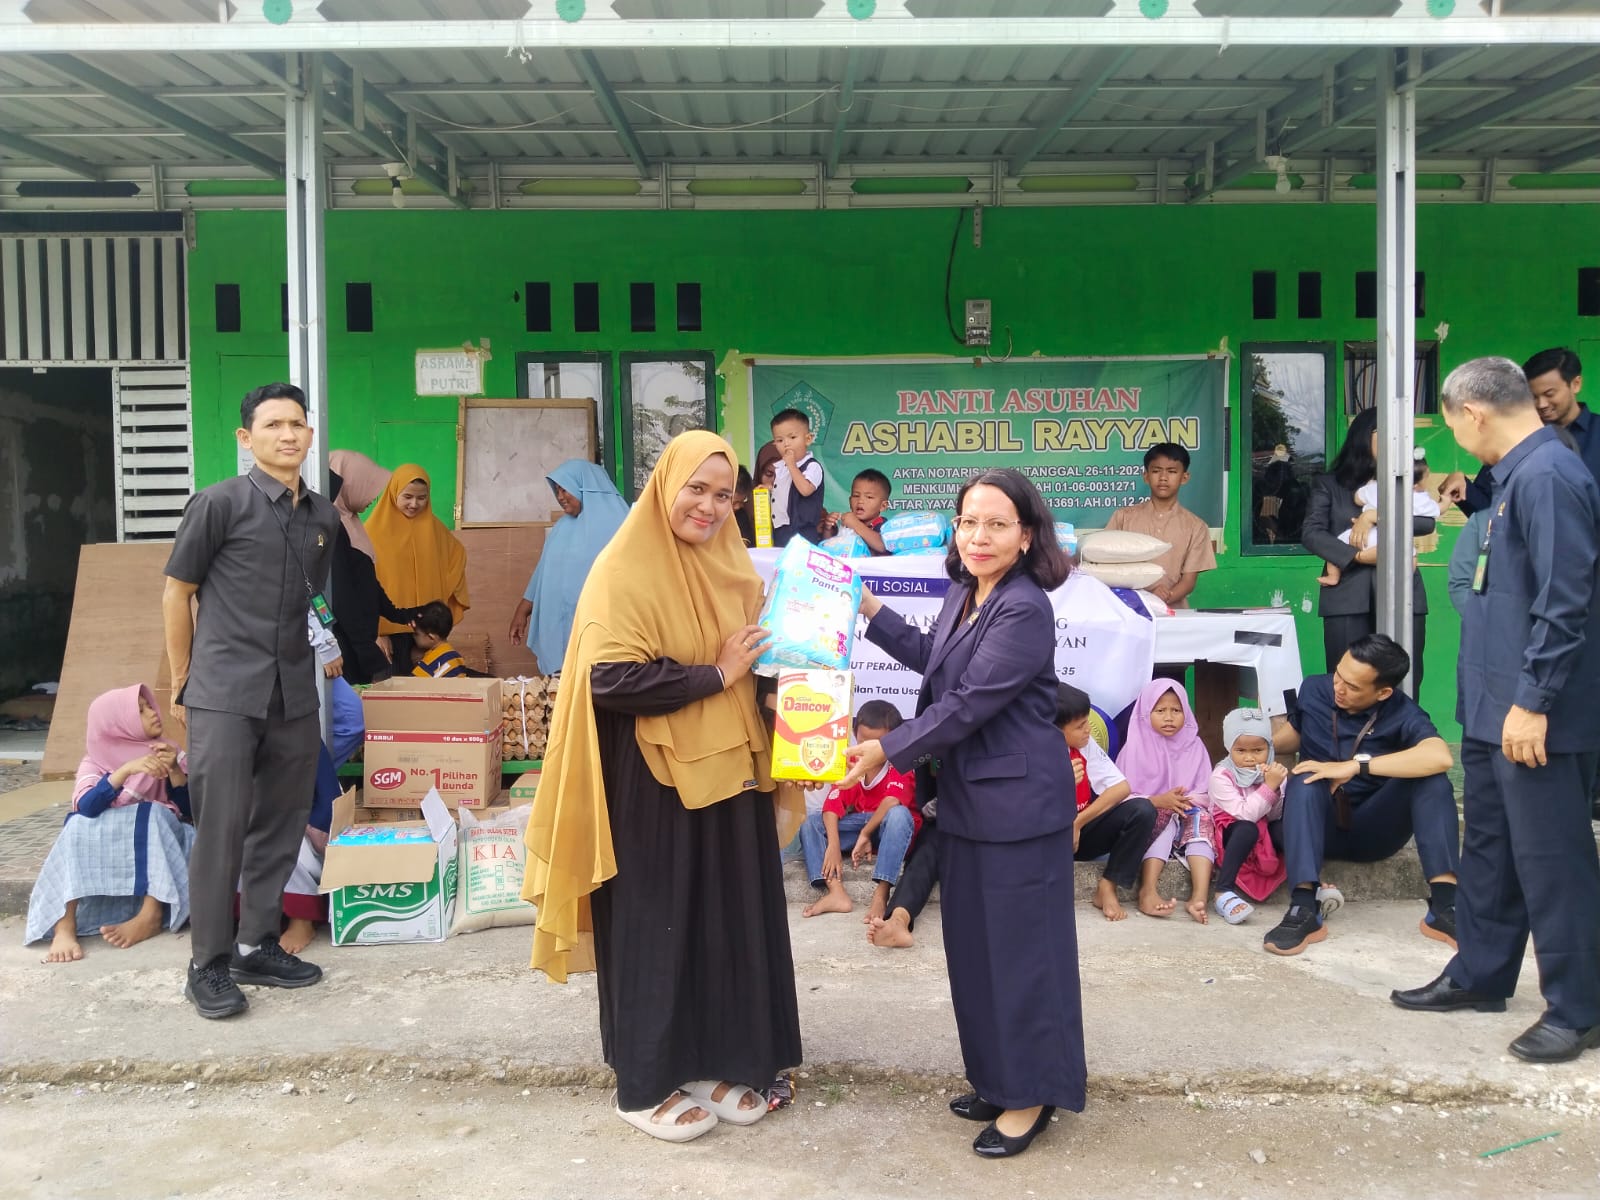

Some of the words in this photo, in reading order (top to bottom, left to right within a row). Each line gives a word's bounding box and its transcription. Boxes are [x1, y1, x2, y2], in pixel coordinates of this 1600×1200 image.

[421, 357, 473, 368] ASRAMA
[431, 378, 468, 389] PUTRI
[898, 391, 993, 415] PANTI
[1002, 388, 1141, 413] ASUHAN
[843, 421, 1022, 454] ASHABIL
[1034, 418, 1200, 452] RAYYAN
[893, 467, 925, 478] AKTA
[928, 467, 980, 478] NOTARIS
[1024, 466, 1082, 477] TANGGAL
[1085, 465, 1145, 477] 26-11-2021
[1055, 481, 1136, 492] 01-06-0031271
[887, 500, 923, 510] AFTAR
[926, 500, 957, 510] YAYA
[812, 577, 840, 592] Pants
[883, 581, 930, 593] SOSIAL
[876, 686, 899, 694] Tata
[902, 687, 920, 695] Usa
[784, 697, 831, 712] Dancow
[831, 724, 847, 738] 1+
[374, 772, 402, 785] SGM
[430, 768, 440, 790] 1
[443, 772, 478, 780] Pilihan
[473, 843, 517, 861] KIA
[353, 883, 414, 899] SMS
